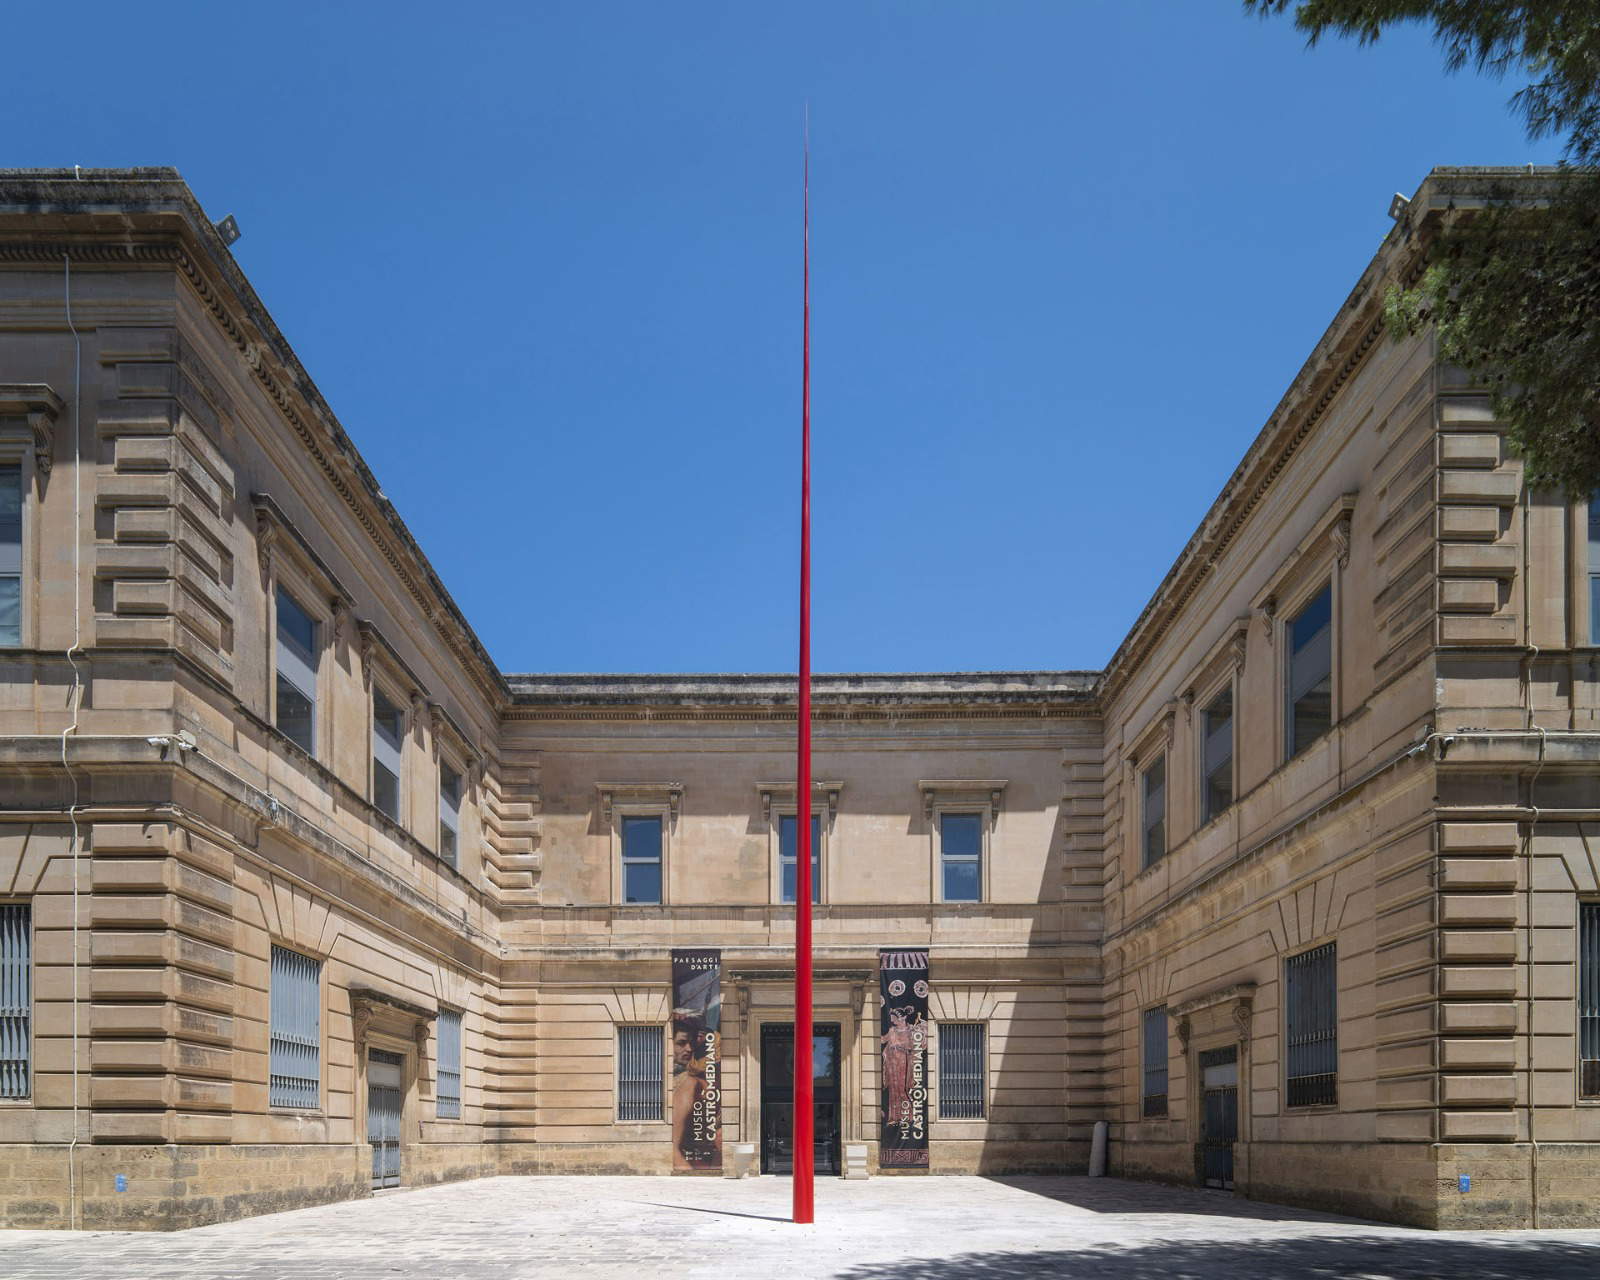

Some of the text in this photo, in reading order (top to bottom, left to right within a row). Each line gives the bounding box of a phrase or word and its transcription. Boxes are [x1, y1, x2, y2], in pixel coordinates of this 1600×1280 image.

[693, 1101, 703, 1141] MUSEO
[706, 1032, 716, 1141] CASTROMEDIANO
[901, 1100, 910, 1139] MUSEO
[913, 1031, 924, 1139] CASTROMEDIANO
